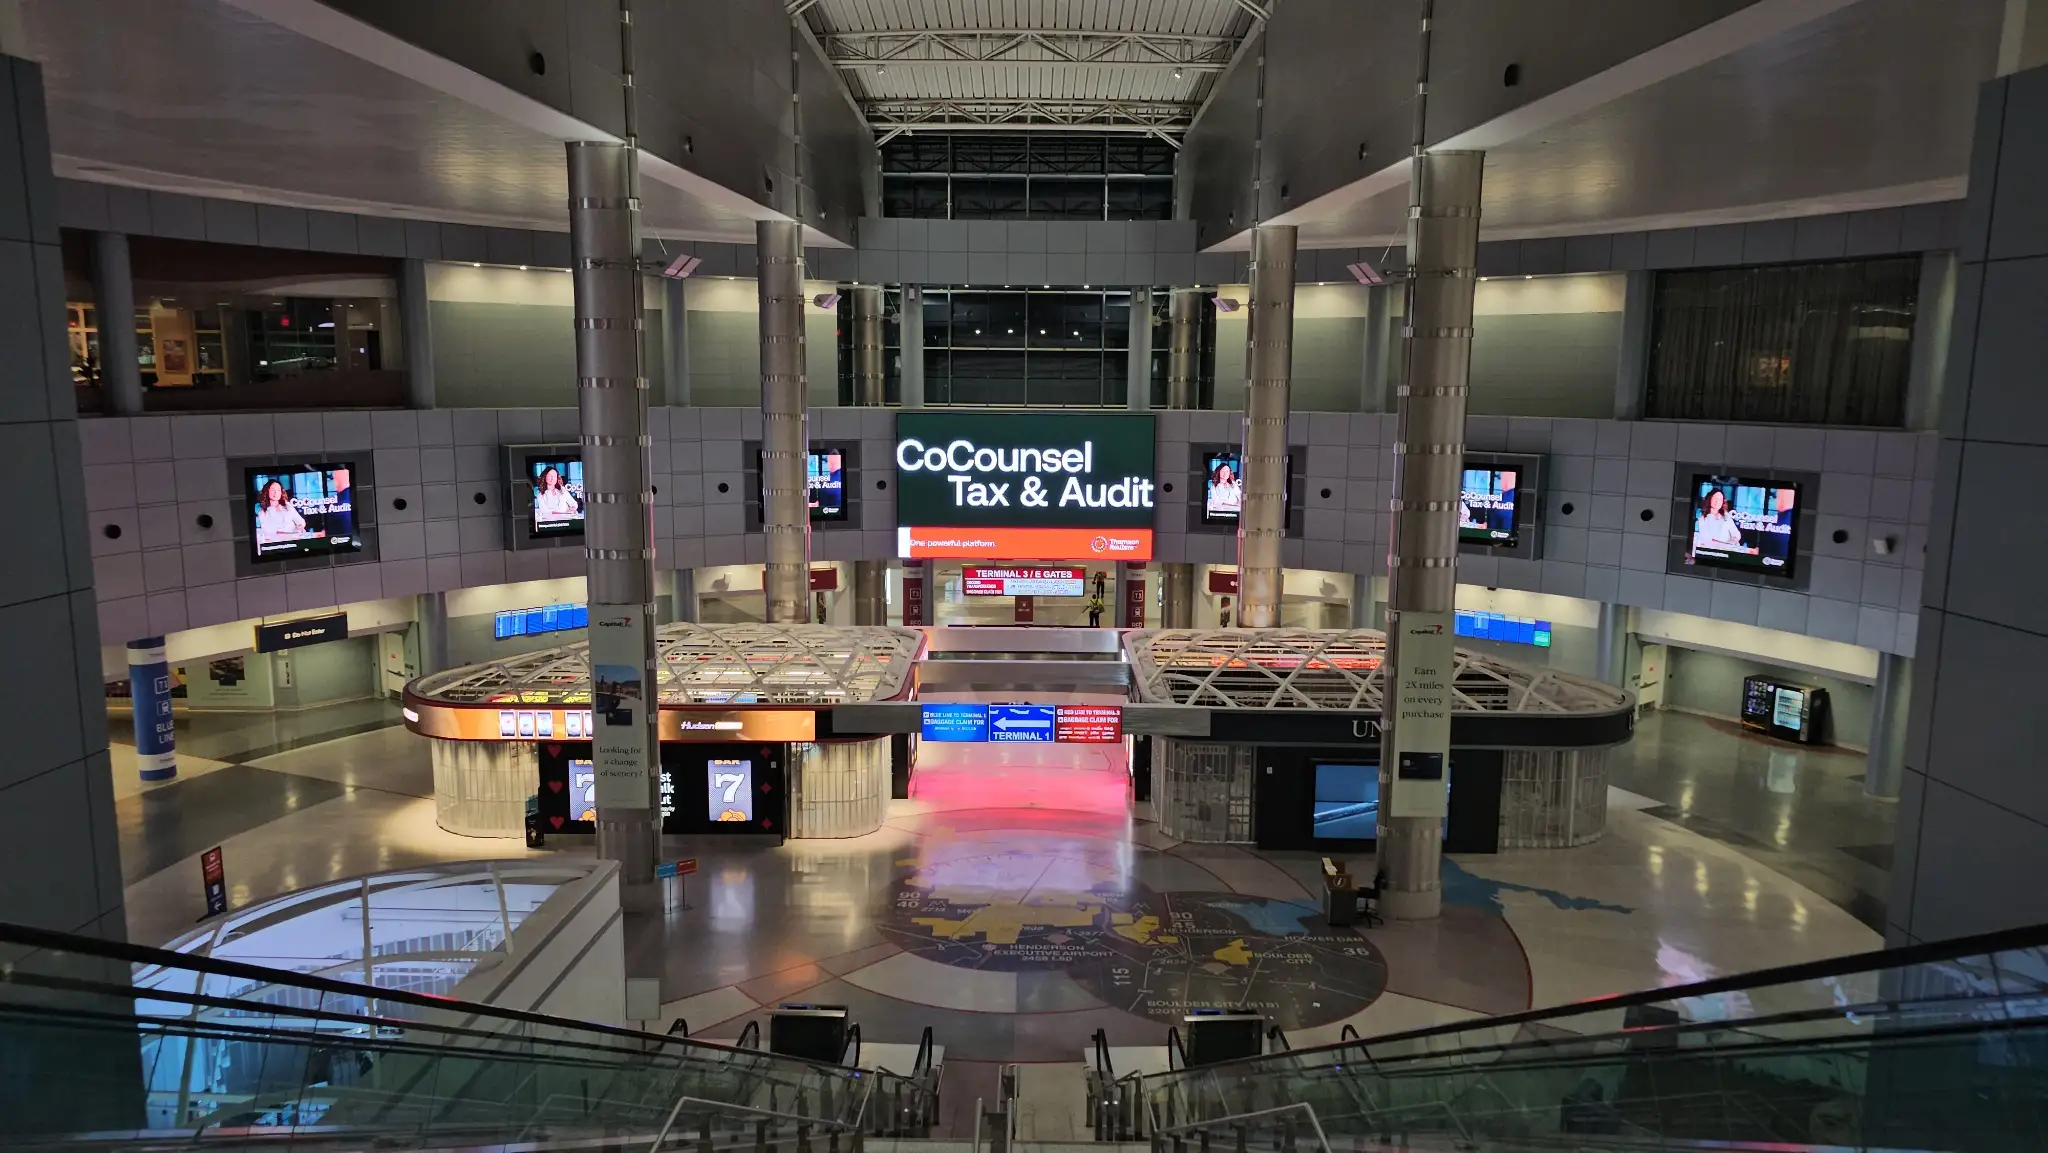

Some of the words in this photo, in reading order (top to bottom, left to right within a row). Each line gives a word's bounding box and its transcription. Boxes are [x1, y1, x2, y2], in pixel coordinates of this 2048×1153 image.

[897, 439, 1092, 473] CoCounsel
[948, 475, 1010, 507] Tax
[1019, 476, 1049, 507] &
[1058, 476, 1154, 508] Audit
[290, 495, 338, 507] CoCounsel
[1469, 500, 1482, 508] Tax
[1492, 502, 1514, 510] Audit
[302, 506, 318, 515] Tax
[328, 503, 351, 513] Audit
[1739, 520, 1755, 530] Tax
[1766, 523, 1791, 534] Audit
[927, 538, 962, 549] powerful
[962, 538, 997, 549] platform.
[976, 570, 1021, 578] TERMINAL
[1023, 570, 1029, 578] 3
[1414, 667, 1436, 675] Earn
[1405, 681, 1417, 689] 2X
[1419, 680, 1444, 690] miles
[1404, 696, 1416, 704] on
[1416, 696, 1442, 705] every
[1402, 710, 1444, 720] purchase
[156, 720, 174, 733] BLUE
[680, 721, 716, 730] Hudson
[159, 732, 174, 744] LINE
[993, 731, 1042, 741] TERMINAL
[1044, 732, 1050, 740] 1
[600, 747, 628, 756] Looking
[611, 758, 638, 768] change
[600, 769, 609, 777] of
[609, 769, 643, 779] scenery?
[660, 783, 674, 794] alk
[714, 773, 745, 804] 7
[660, 795, 671, 805] ut
[897, 900, 920, 909] 40
[1284, 935, 1335, 943] HOOVER
[1342, 947, 1370, 956] 36
[1147, 1000, 1213, 1008] BOULDER
[1213, 1001, 1241, 1009] CITY
